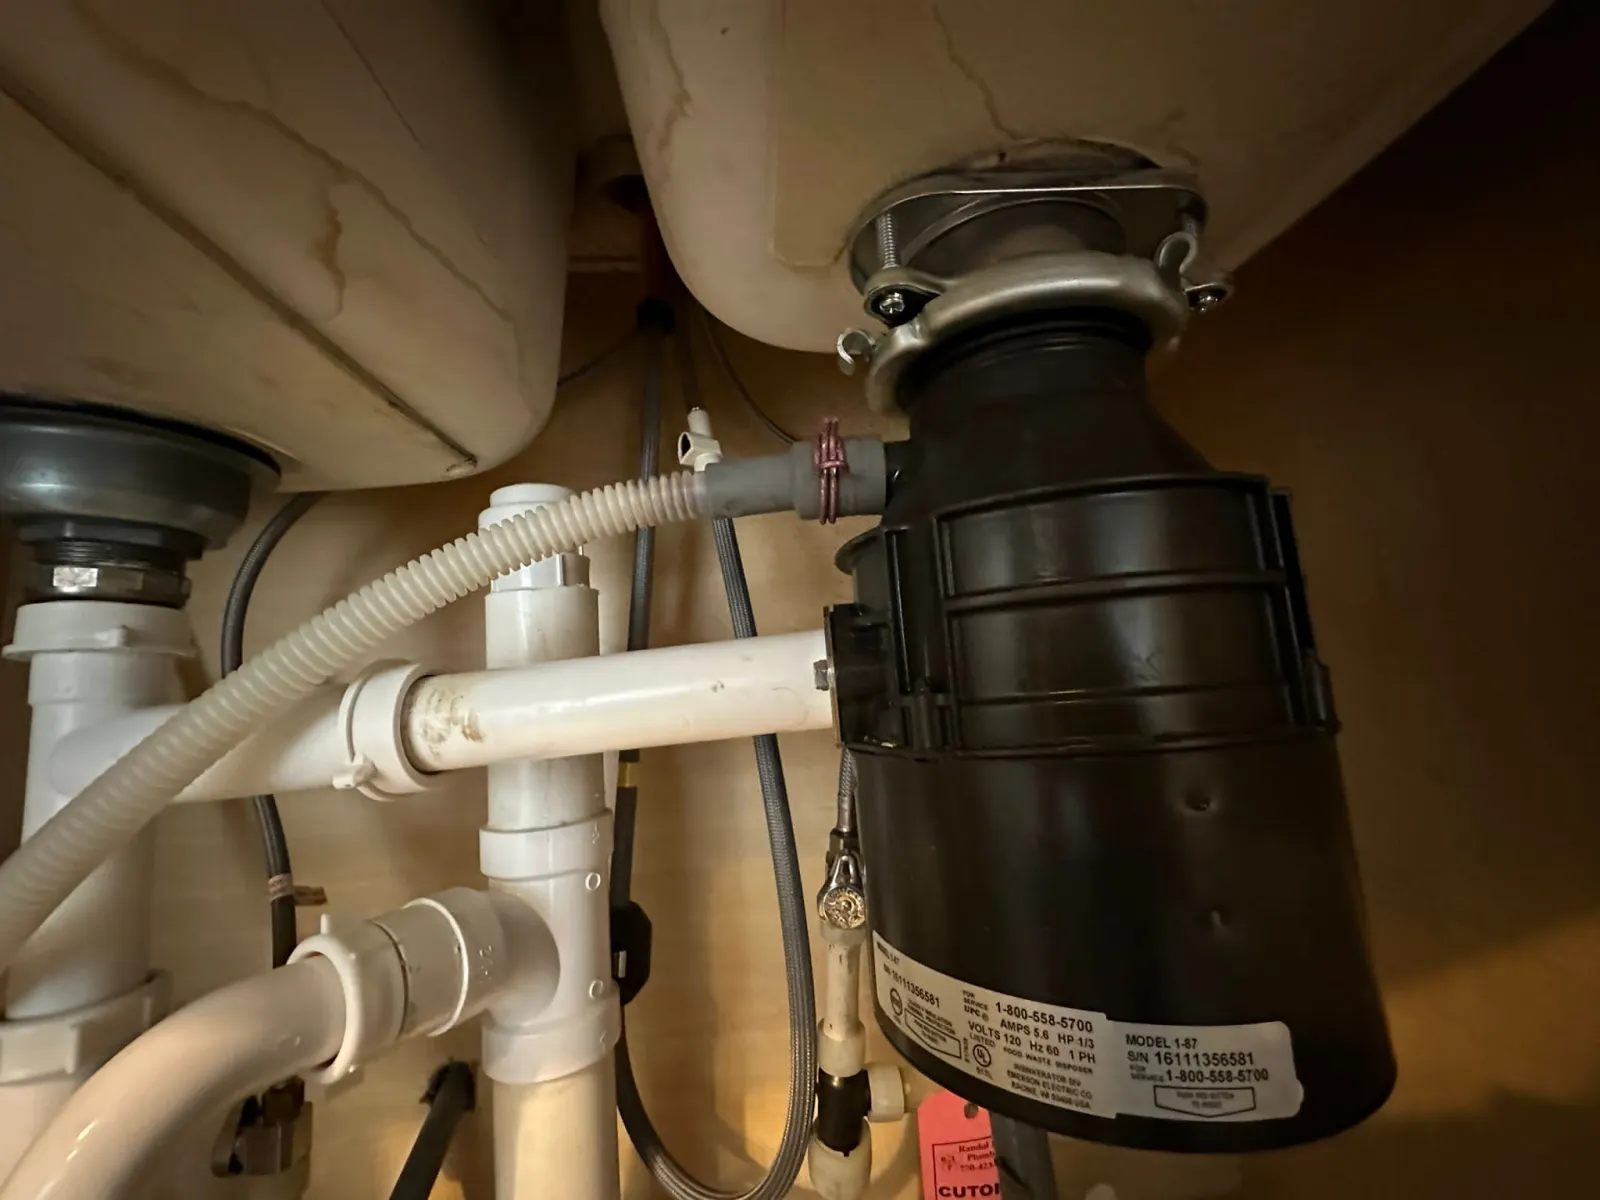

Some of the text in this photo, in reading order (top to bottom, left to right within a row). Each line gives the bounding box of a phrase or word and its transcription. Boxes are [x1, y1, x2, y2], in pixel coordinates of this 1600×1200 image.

[964, 1005, 980, 1017] UPC
[995, 1001, 1093, 1033] 1-800-558-5700
[970, 1032, 996, 1048] LISTED
[1000, 1018, 1095, 1049] AMPS 5.6 HP 1/3
[1125, 1034, 1198, 1049] MODEL 1-87
[968, 1020, 1096, 1064] VOLTS 120 Hz 60 1 PH
[1003, 1046, 1093, 1074] FOOD WASTE DISPOSER
[1127, 1051, 1254, 1067] S/N 16111356581
[1166, 1068, 1269, 1083] 1-800-558-5700
